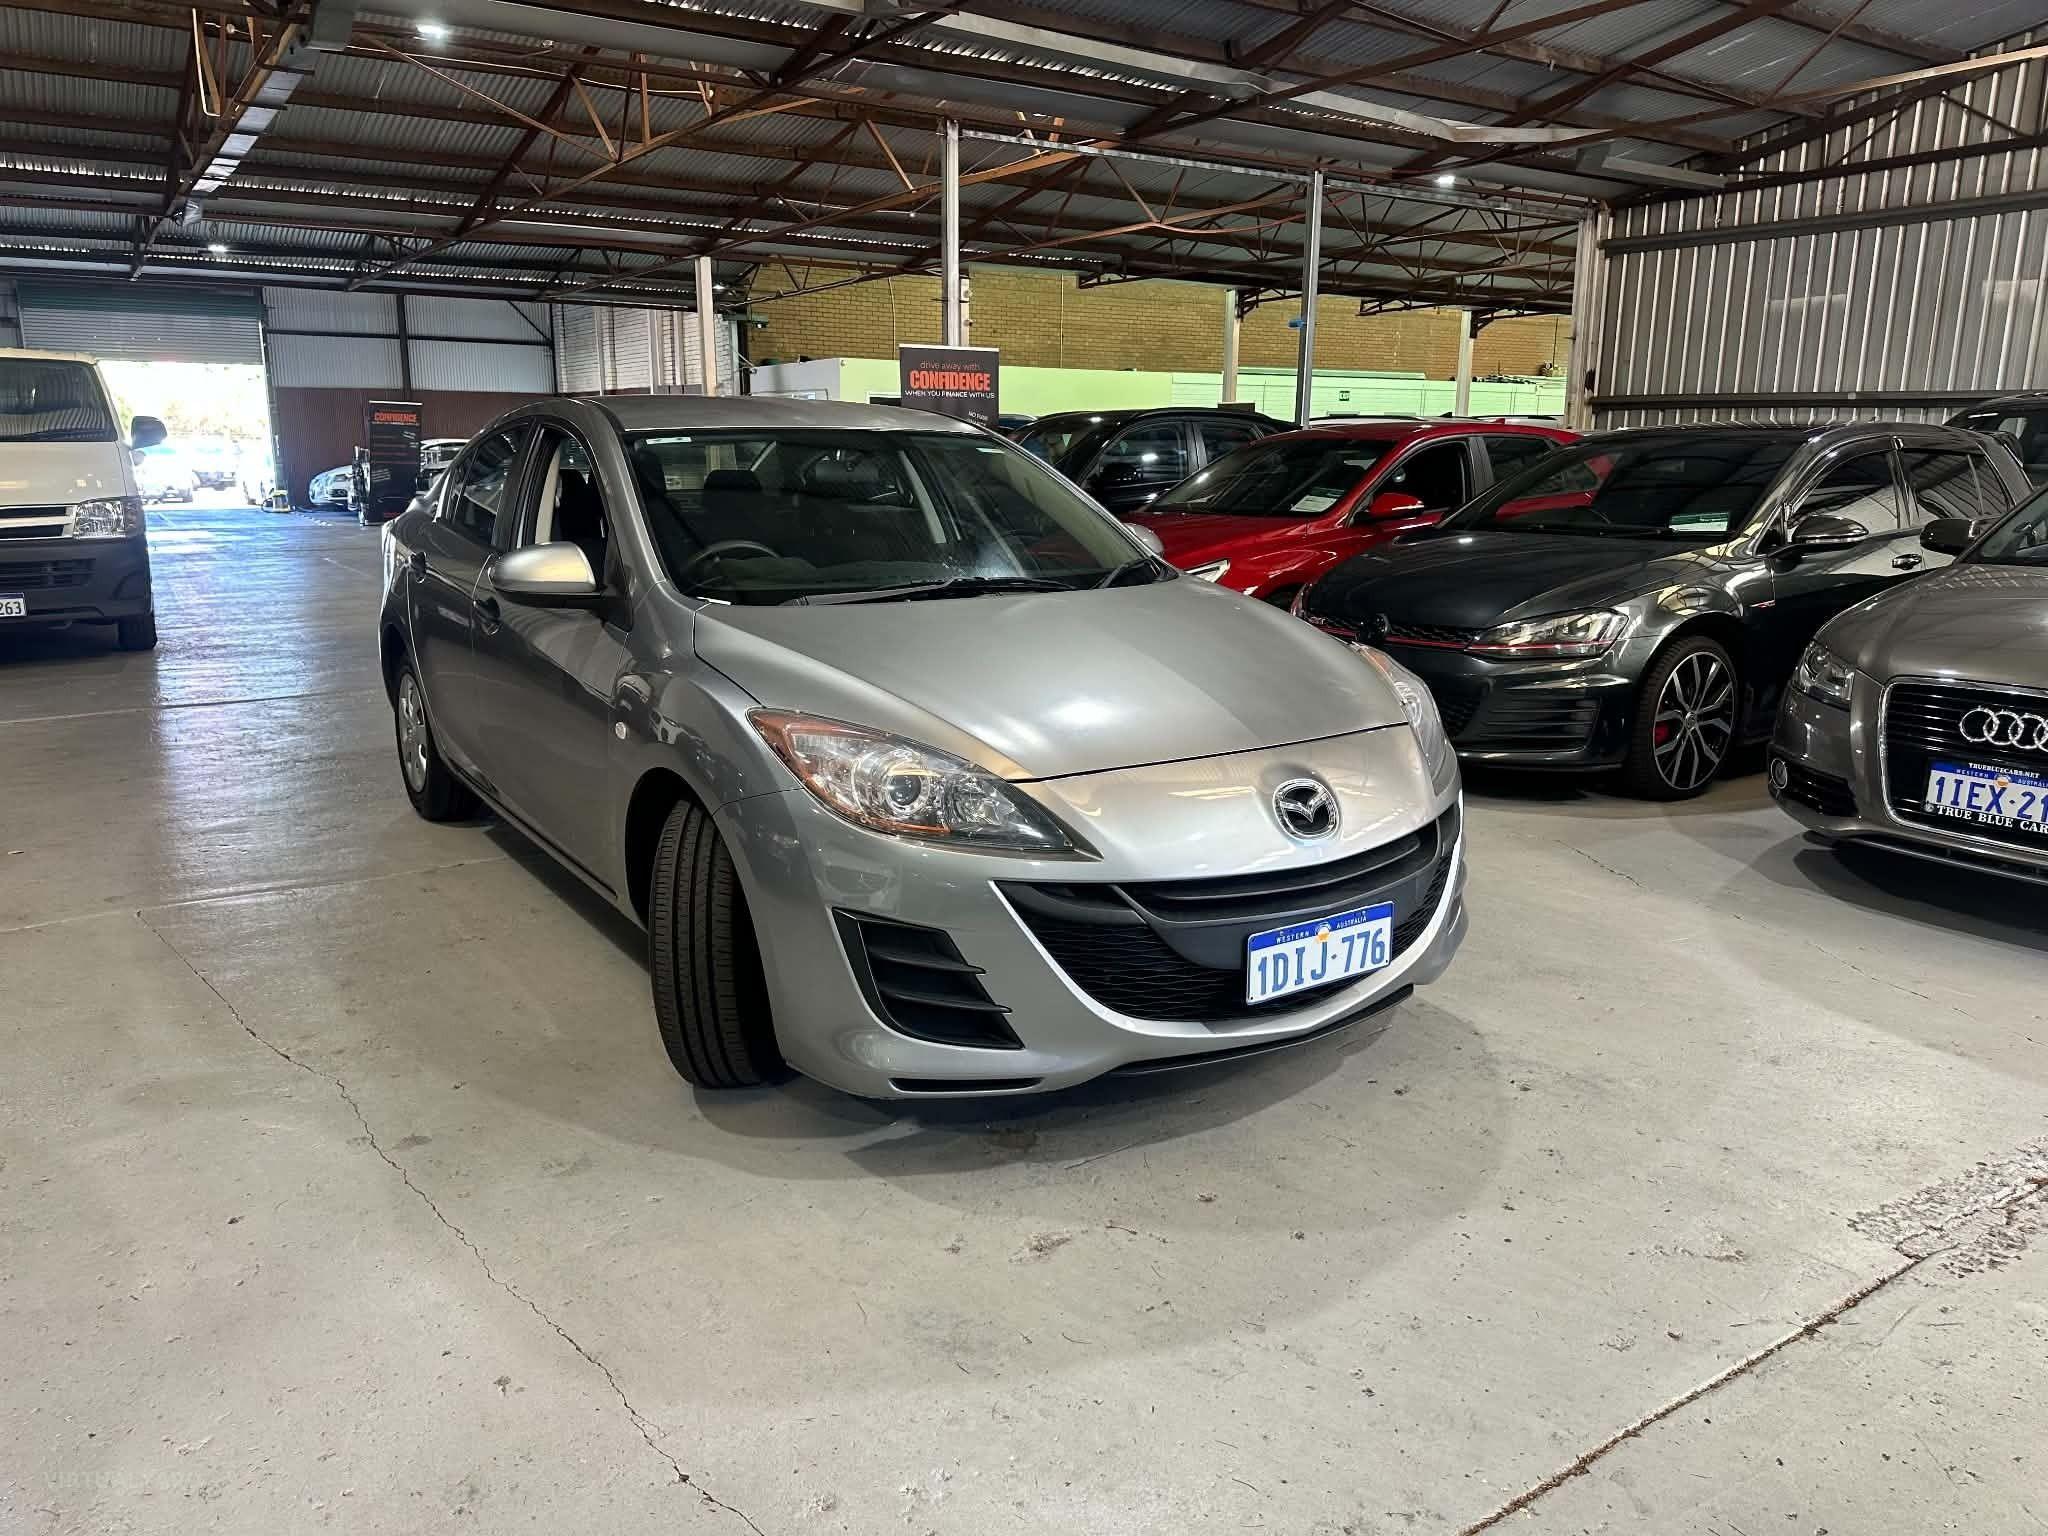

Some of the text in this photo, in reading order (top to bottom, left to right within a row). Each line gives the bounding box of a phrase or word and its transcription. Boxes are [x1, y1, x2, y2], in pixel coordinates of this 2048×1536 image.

[920, 360, 939, 369] drive
[941, 361, 960, 371] away
[910, 370, 991, 391] CONFIDENCE
[905, 389, 925, 397] WHEN
[1956, 769, 1989, 778] WESTERN
[1968, 763, 2040, 778] TRUEBLUECARS.NET
[1937, 804, 1972, 820] TRUE
[1978, 813, 2014, 828] BLUE
[1276, 916, 1367, 944] WESTERN AUSTRALIA
